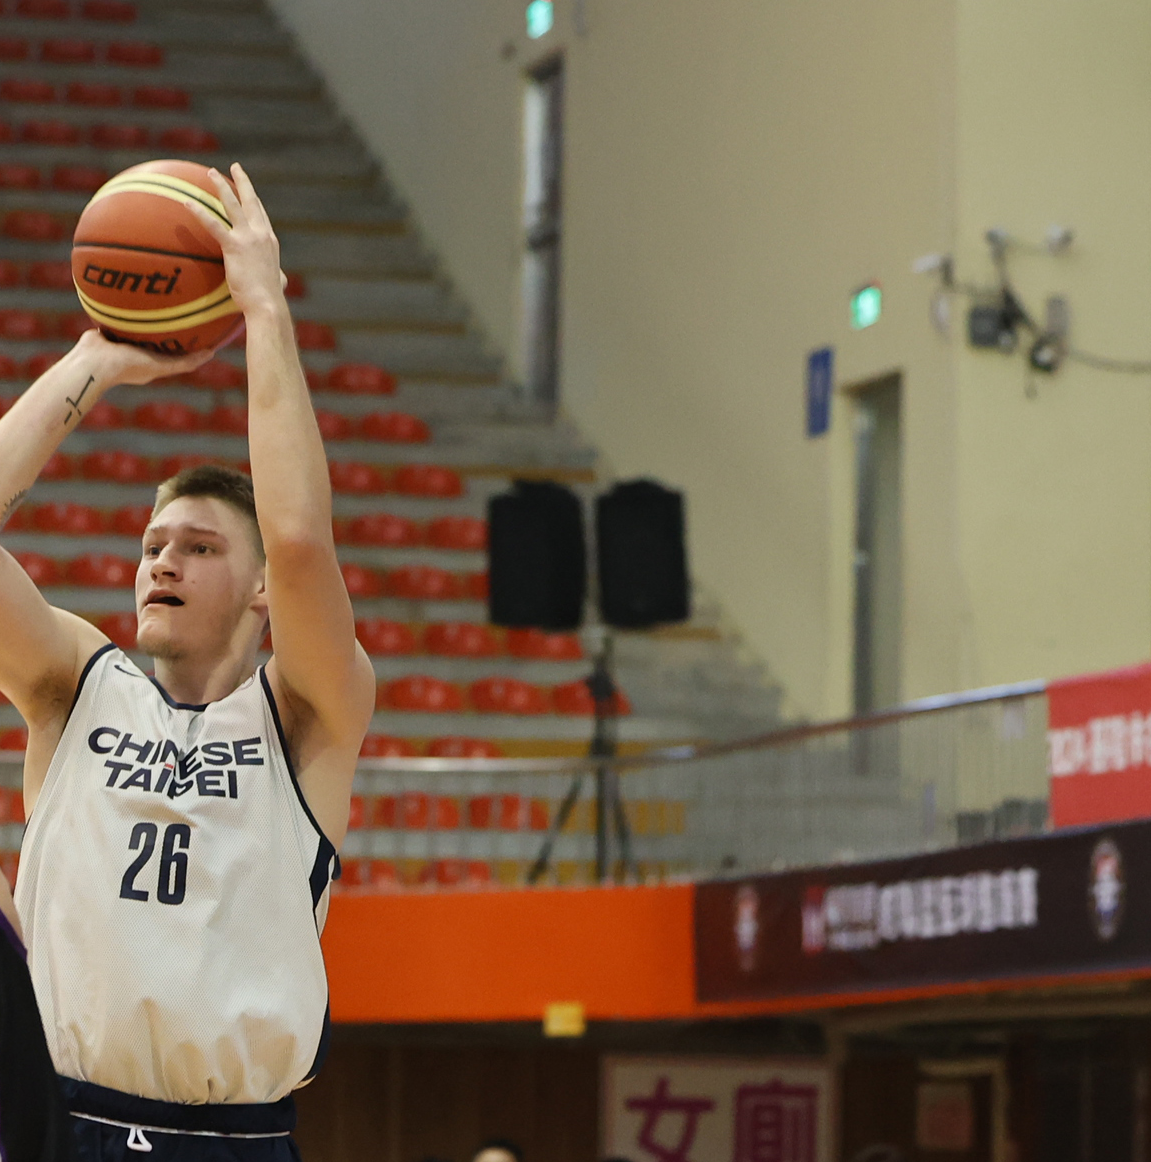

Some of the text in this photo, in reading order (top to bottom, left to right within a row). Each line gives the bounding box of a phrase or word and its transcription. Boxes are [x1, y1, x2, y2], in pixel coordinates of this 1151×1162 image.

[83, 264, 182, 295] conti
[88, 727, 264, 780] CHINESE
[104, 760, 238, 800] TAIPEI
[119, 822, 191, 905] 26
